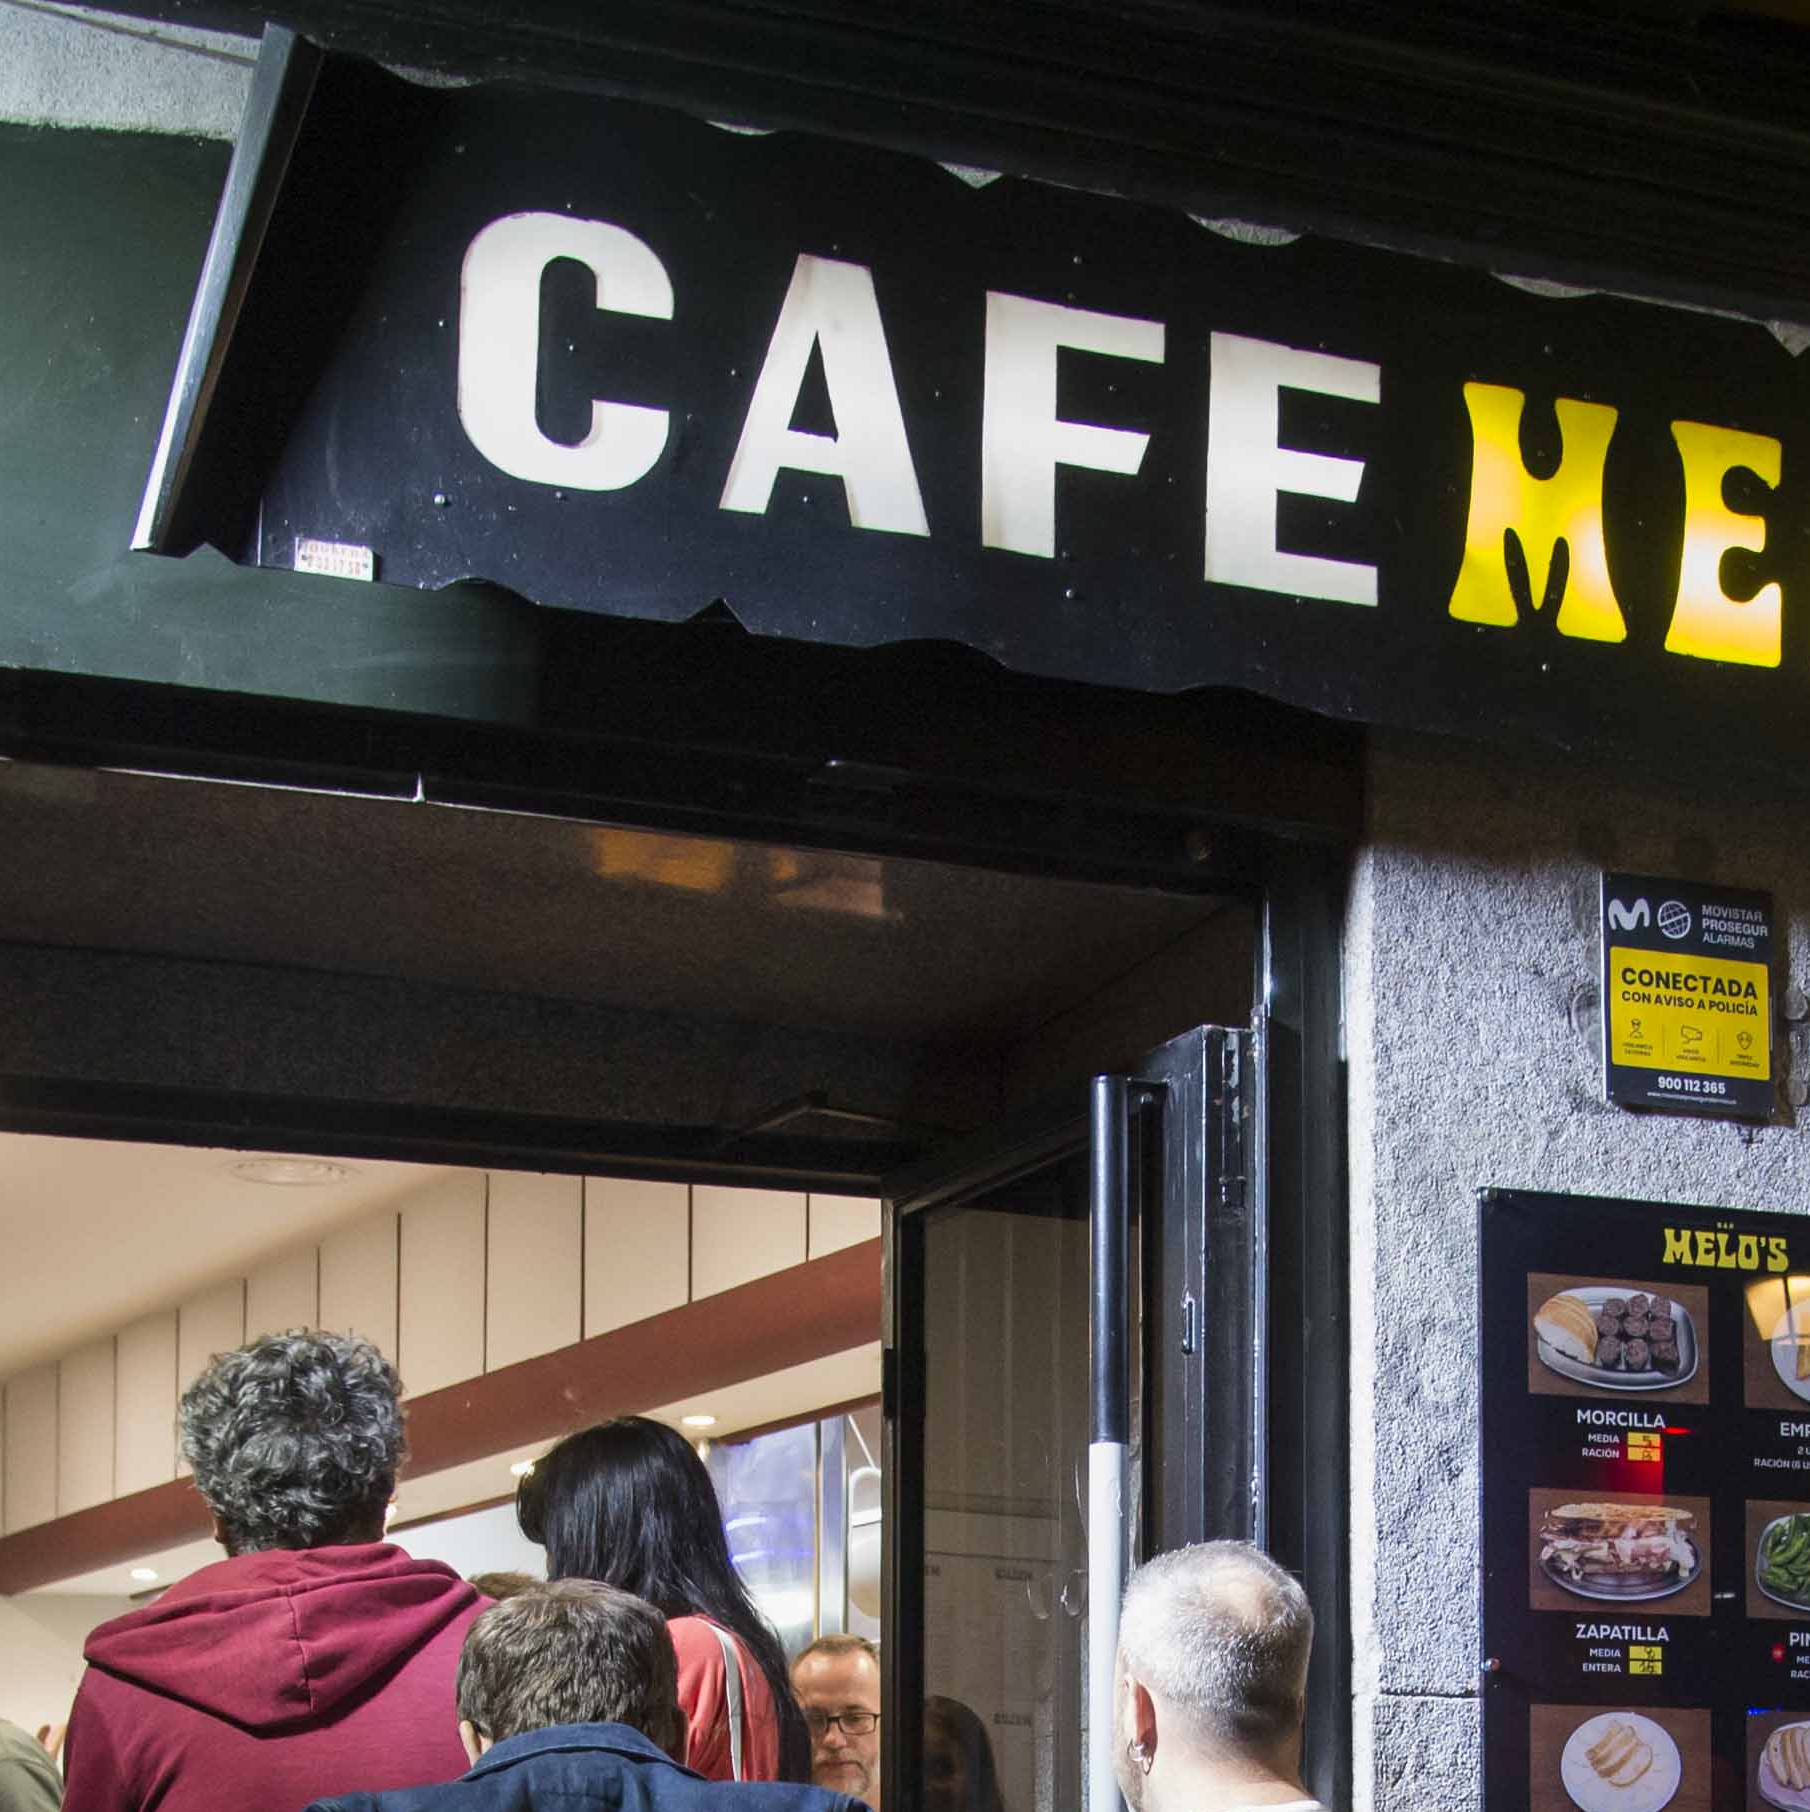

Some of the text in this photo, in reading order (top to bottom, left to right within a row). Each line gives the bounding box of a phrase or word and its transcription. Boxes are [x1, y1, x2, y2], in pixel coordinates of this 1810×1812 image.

[458, 211, 1381, 607] CAFE
[1702, 904, 1763, 923] MOVISTAR
[1702, 918, 1768, 937] PROSEGUR
[1702, 932, 1755, 949] ALARMAS
[1621, 967, 1758, 1000] CONECTADA
[1622, 990, 1758, 1017] CON AVISO A POLICÍA
[1658, 1076, 1726, 1095] 900 112 365
[1663, 1228, 1790, 1273] MELO'S
[1577, 1409, 1666, 1428] MORCILLA
[1588, 1432, 1620, 1444] MEDIA
[1582, 1446, 1620, 1459] RACIÓN
[1797, 1446, 1804, 1457] 2
[1753, 1456, 1789, 1470] RACIÓN
[1575, 1624, 1670, 1641] ZAPATILLA
[1590, 1647, 1621, 1658] MEDIA
[1582, 1661, 1621, 1673] ENTERA
